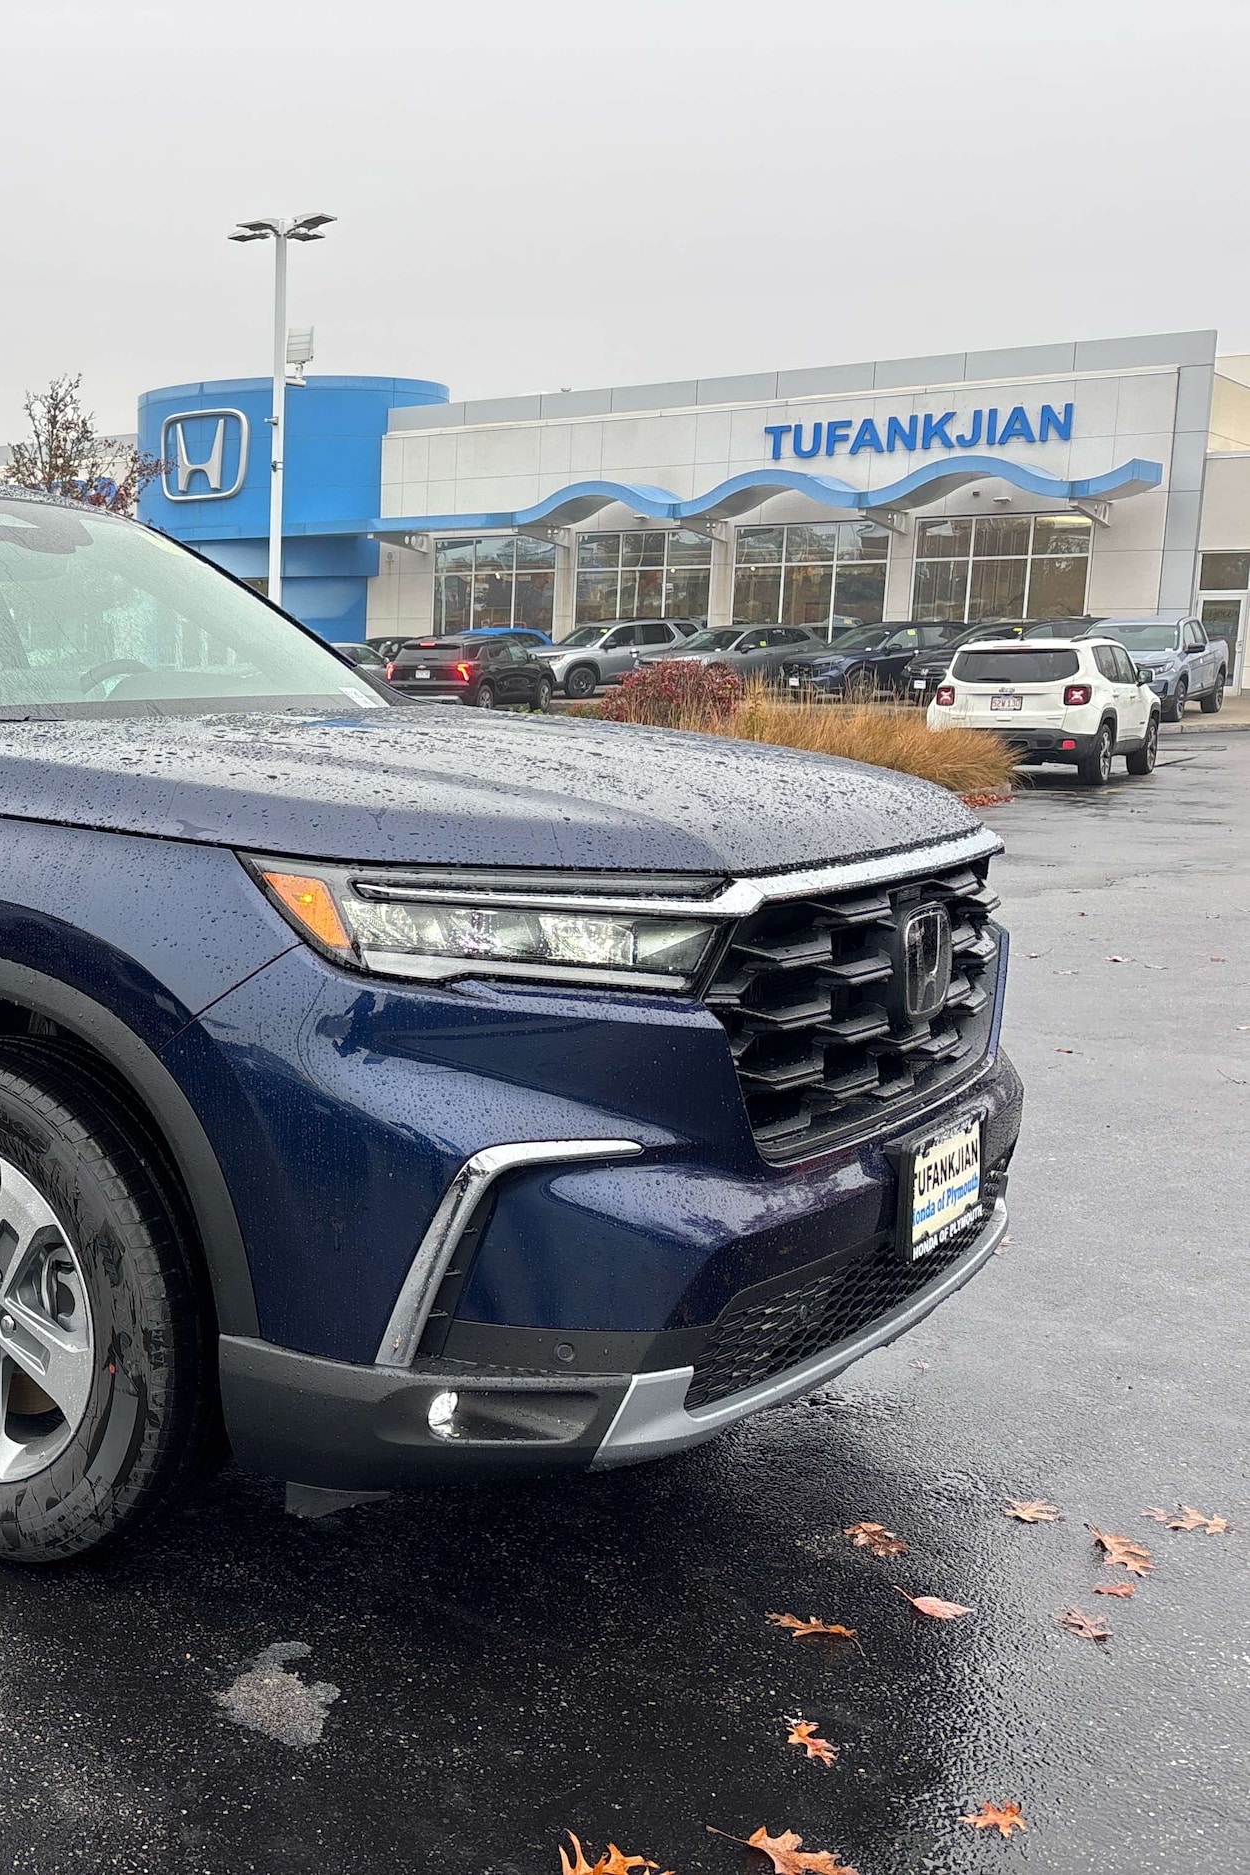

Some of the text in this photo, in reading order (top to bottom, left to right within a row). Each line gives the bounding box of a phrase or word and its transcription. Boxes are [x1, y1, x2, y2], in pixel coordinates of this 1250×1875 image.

[764, 402, 1074, 461] TUFANKJIAN
[937, 1191, 946, 1212] of
[946, 1171, 979, 1207] Plymouth
[912, 1203, 983, 1261] HONDA OF PLYMOUTH
